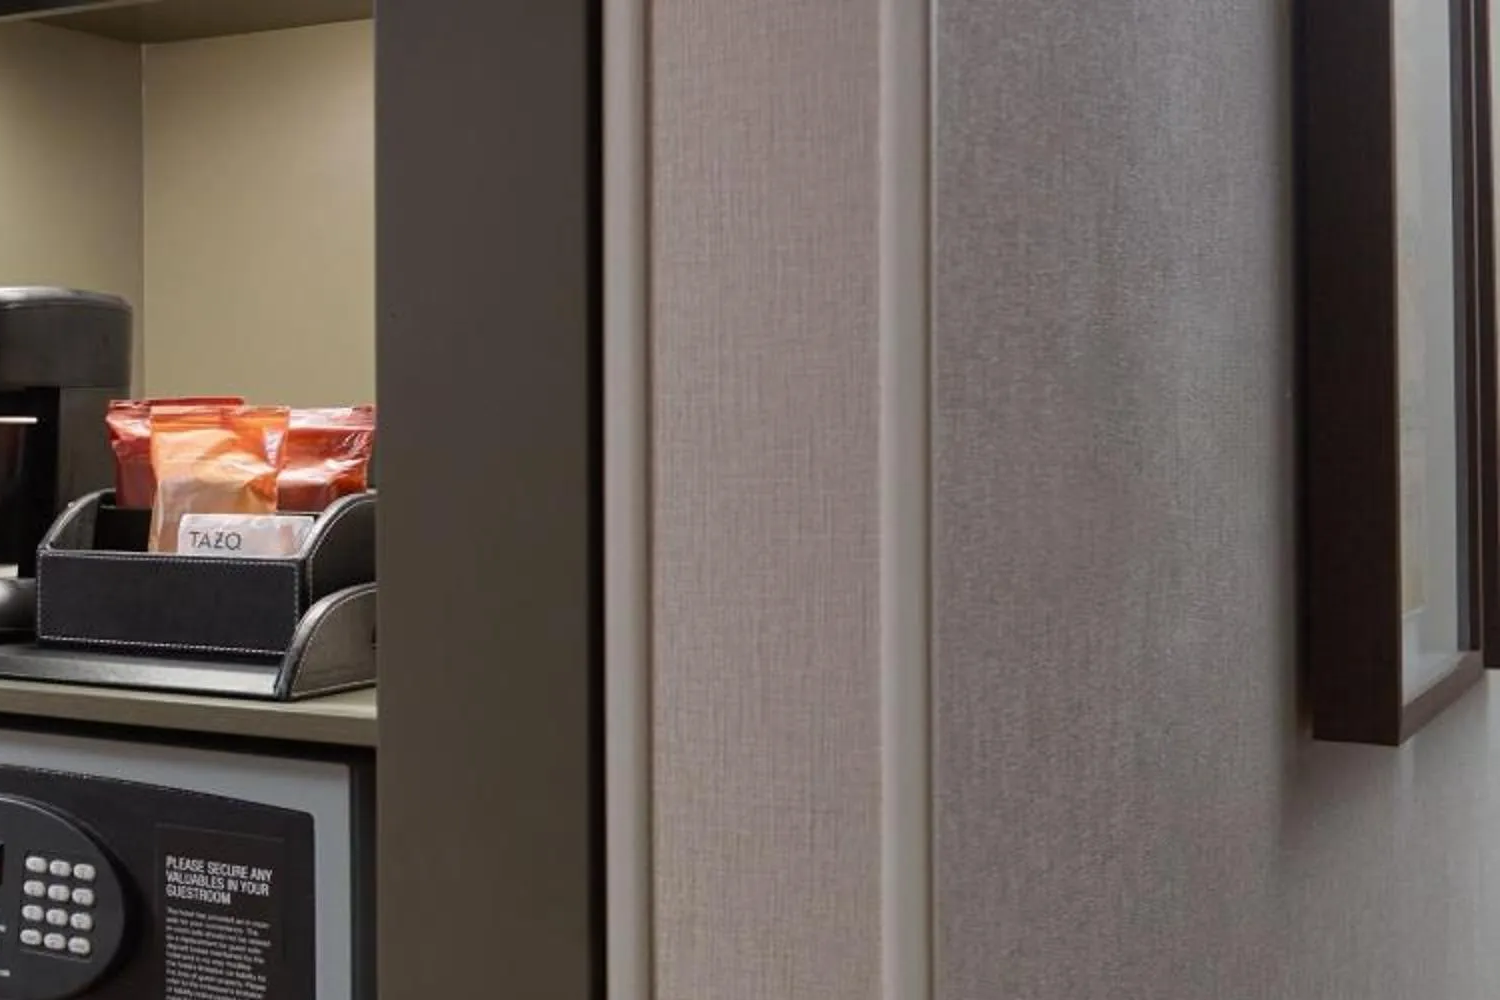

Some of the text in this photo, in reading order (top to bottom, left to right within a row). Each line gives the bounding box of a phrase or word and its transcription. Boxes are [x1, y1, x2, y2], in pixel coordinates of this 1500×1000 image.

[165, 855, 273, 881] PLEASE SECURE ANY
[165, 869, 269, 896] VALUABLES IN YOUR
[165, 883, 231, 904] GUESTROOM
